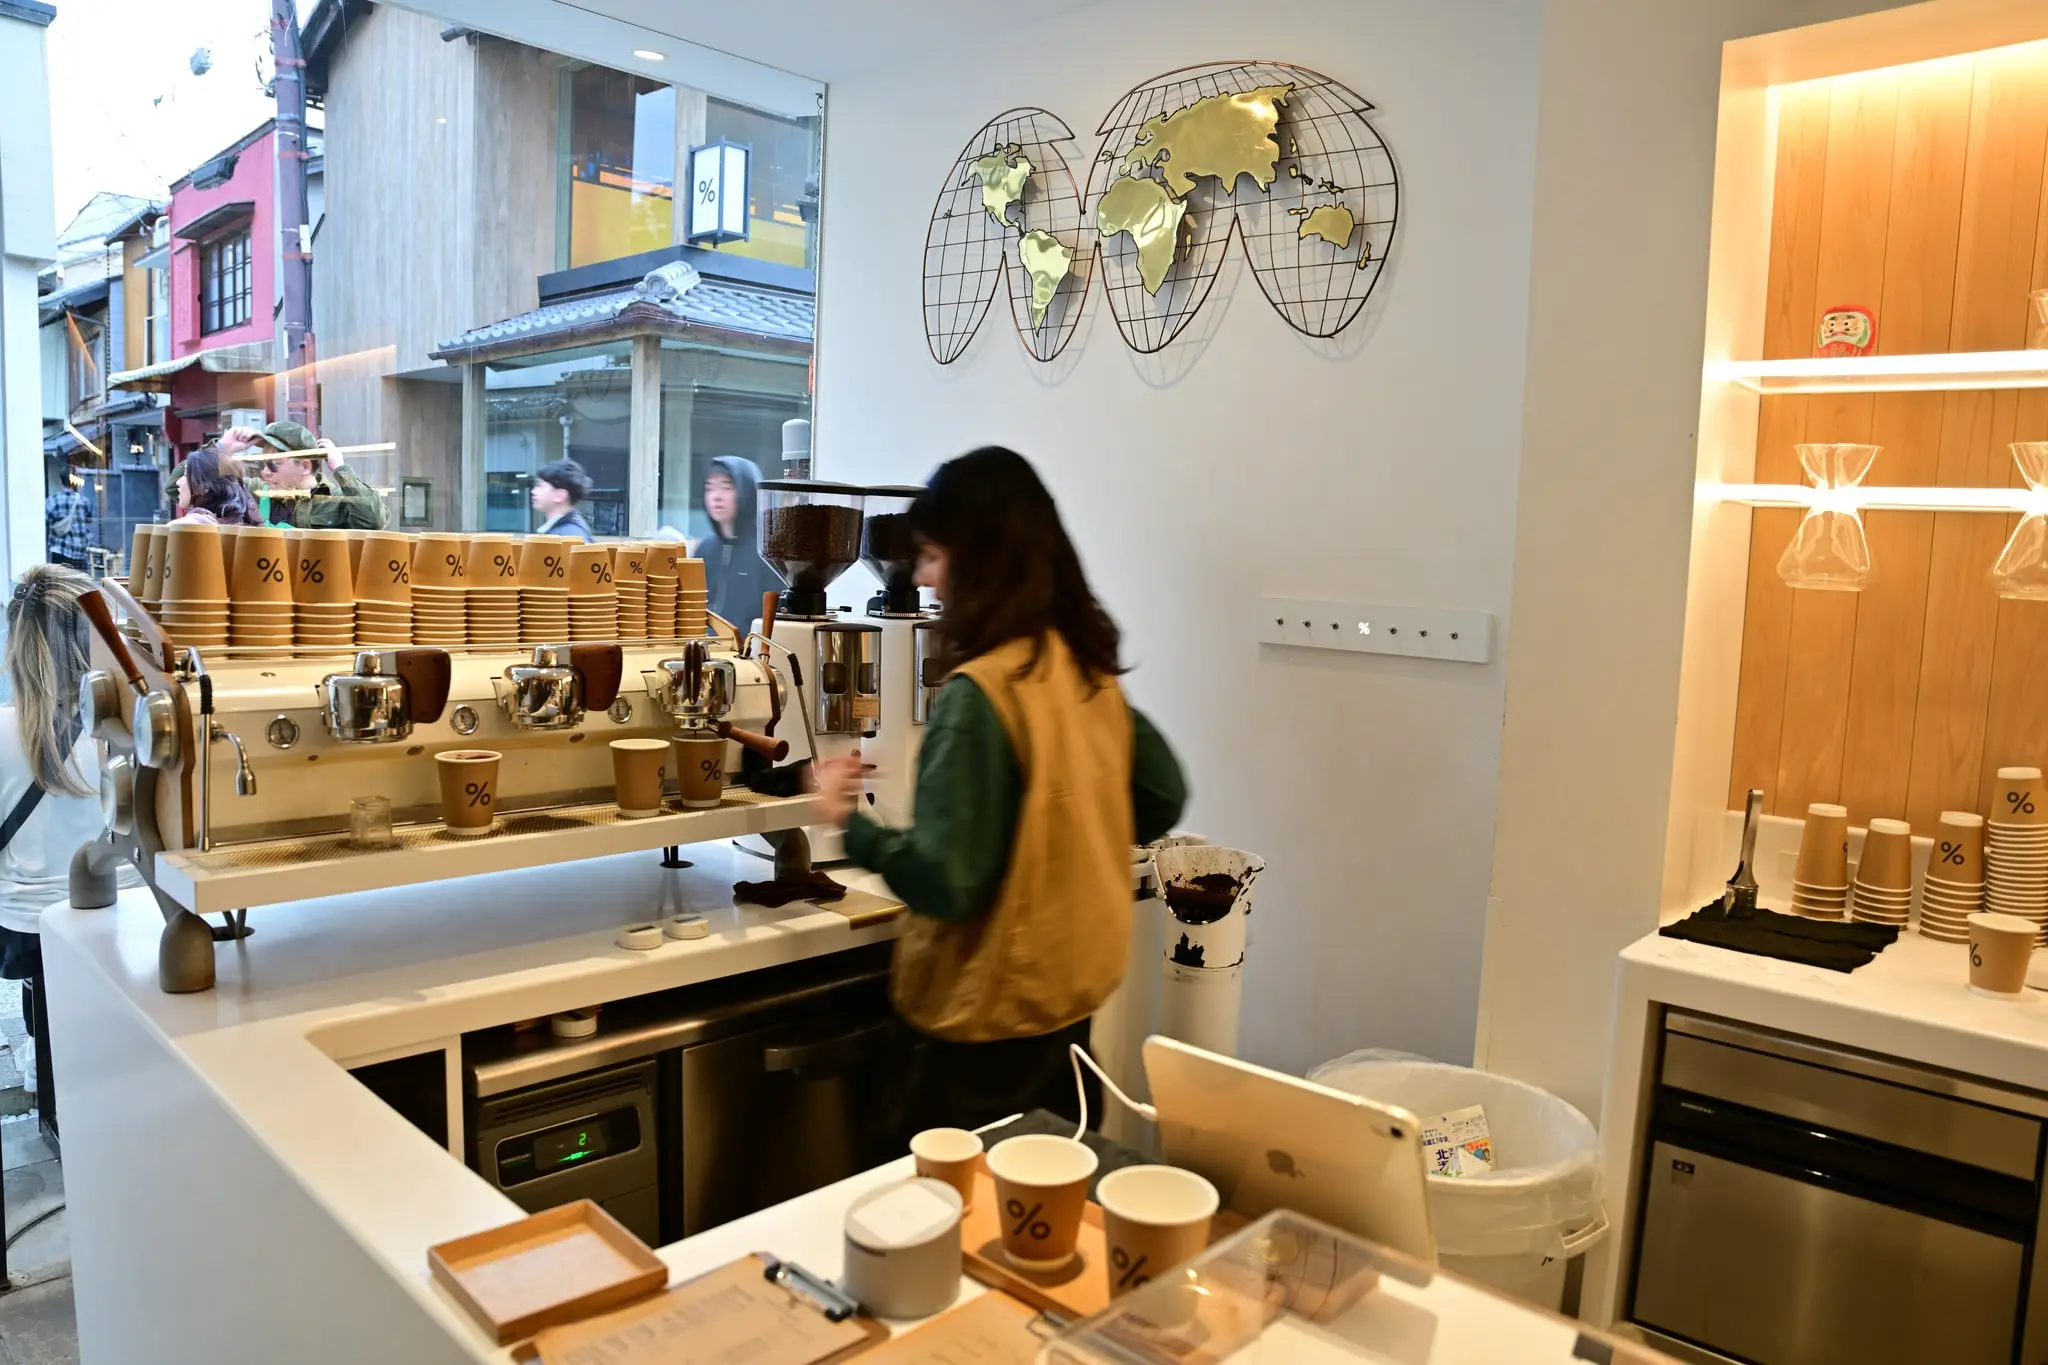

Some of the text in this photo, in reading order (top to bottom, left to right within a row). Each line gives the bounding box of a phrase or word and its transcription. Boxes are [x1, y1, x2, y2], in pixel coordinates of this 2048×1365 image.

[699, 178, 715, 205] %
[257, 557, 284, 582] %
[301, 558, 324, 583] %
[388, 559, 409, 584] %
[494, 555, 515, 577] %
[544, 556, 564, 578] %
[591, 562, 612, 583] %
[630, 561, 643, 574] %
[1358, 621, 1370, 635] %
[701, 759, 722, 782] %
[465, 781, 491, 807] %
[2007, 792, 2035, 814] %
[1941, 841, 1965, 865] %
[579, 1132, 587, 1146] 2
[1006, 1198, 1051, 1240] %
